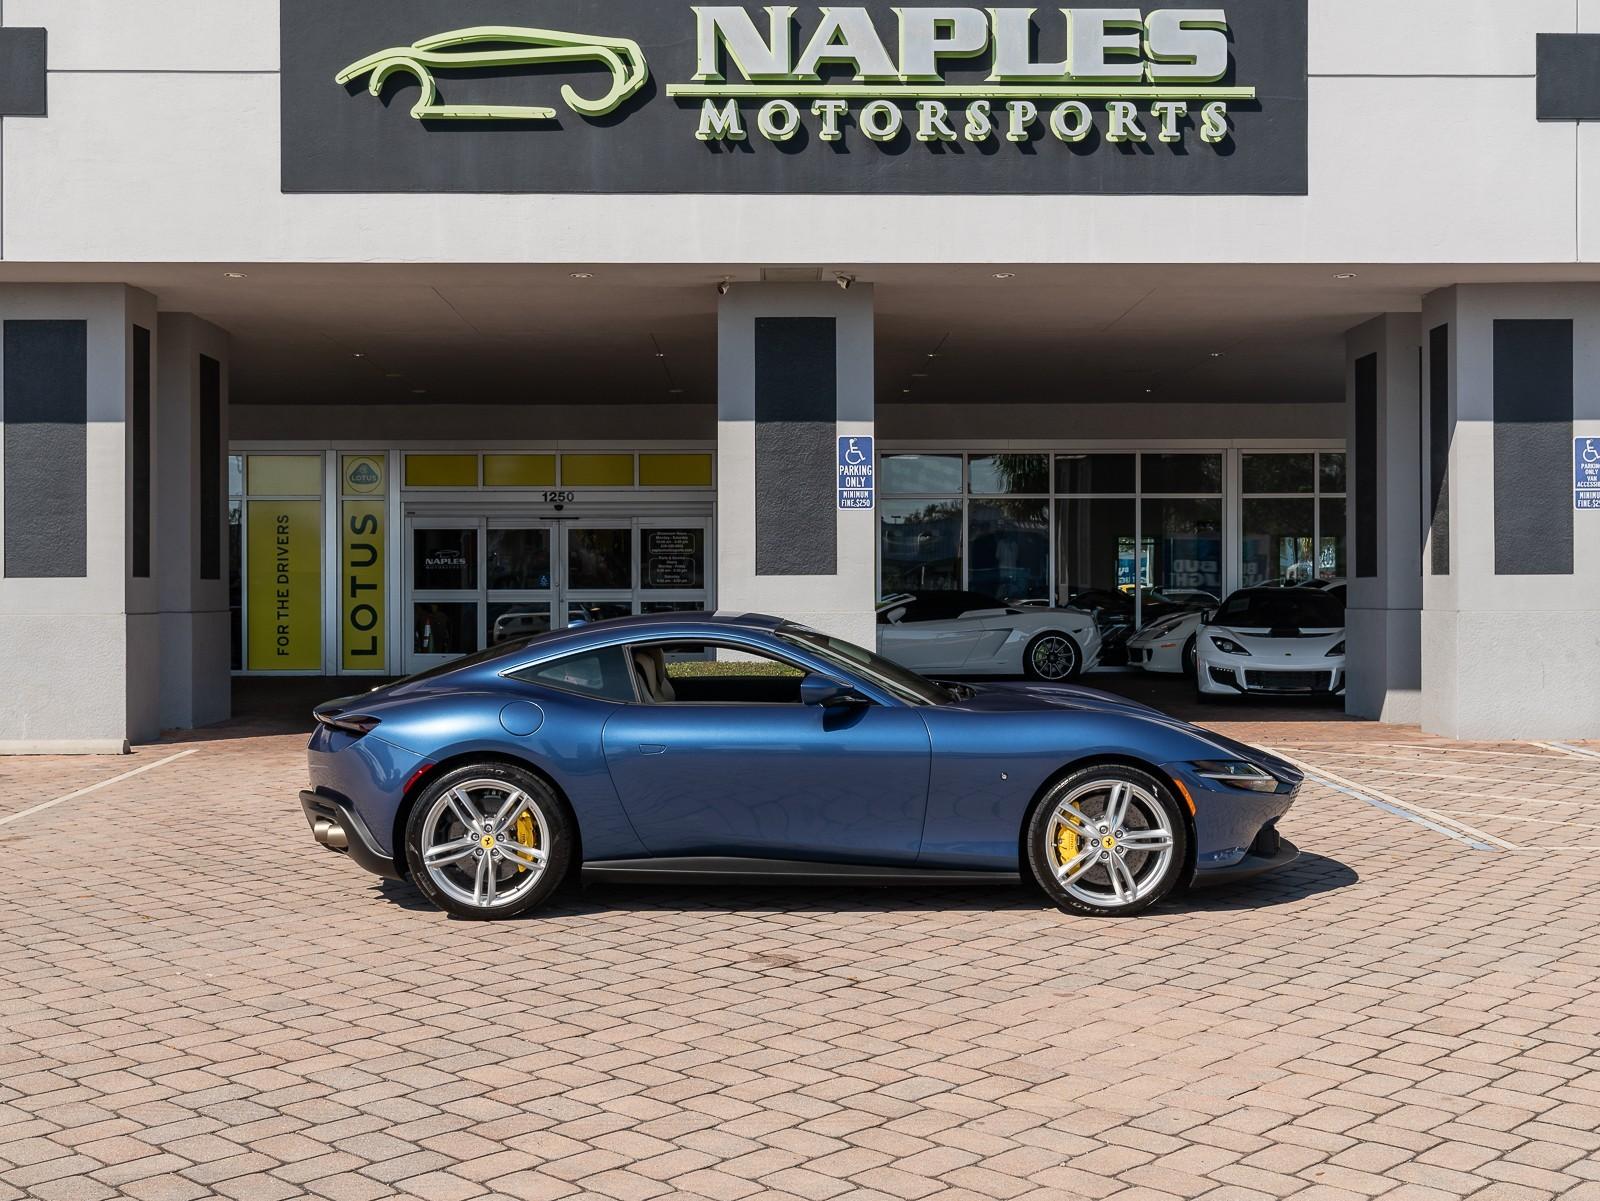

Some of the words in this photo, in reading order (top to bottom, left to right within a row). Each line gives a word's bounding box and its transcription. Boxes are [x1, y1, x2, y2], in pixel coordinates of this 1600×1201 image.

[690, 6, 1229, 82] NAPLES
[695, 98, 1229, 142] MOTORSPORTS
[839, 465, 872, 475] PARKING
[846, 477, 865, 487] ONLY
[542, 490, 576, 503] 1250
[277, 514, 289, 584] DRIVERS
[425, 557, 466, 565] NAPLES
[350, 513, 378, 656] LOTUS
[277, 589, 289, 620] THE
[277, 625, 289, 656] FOR
